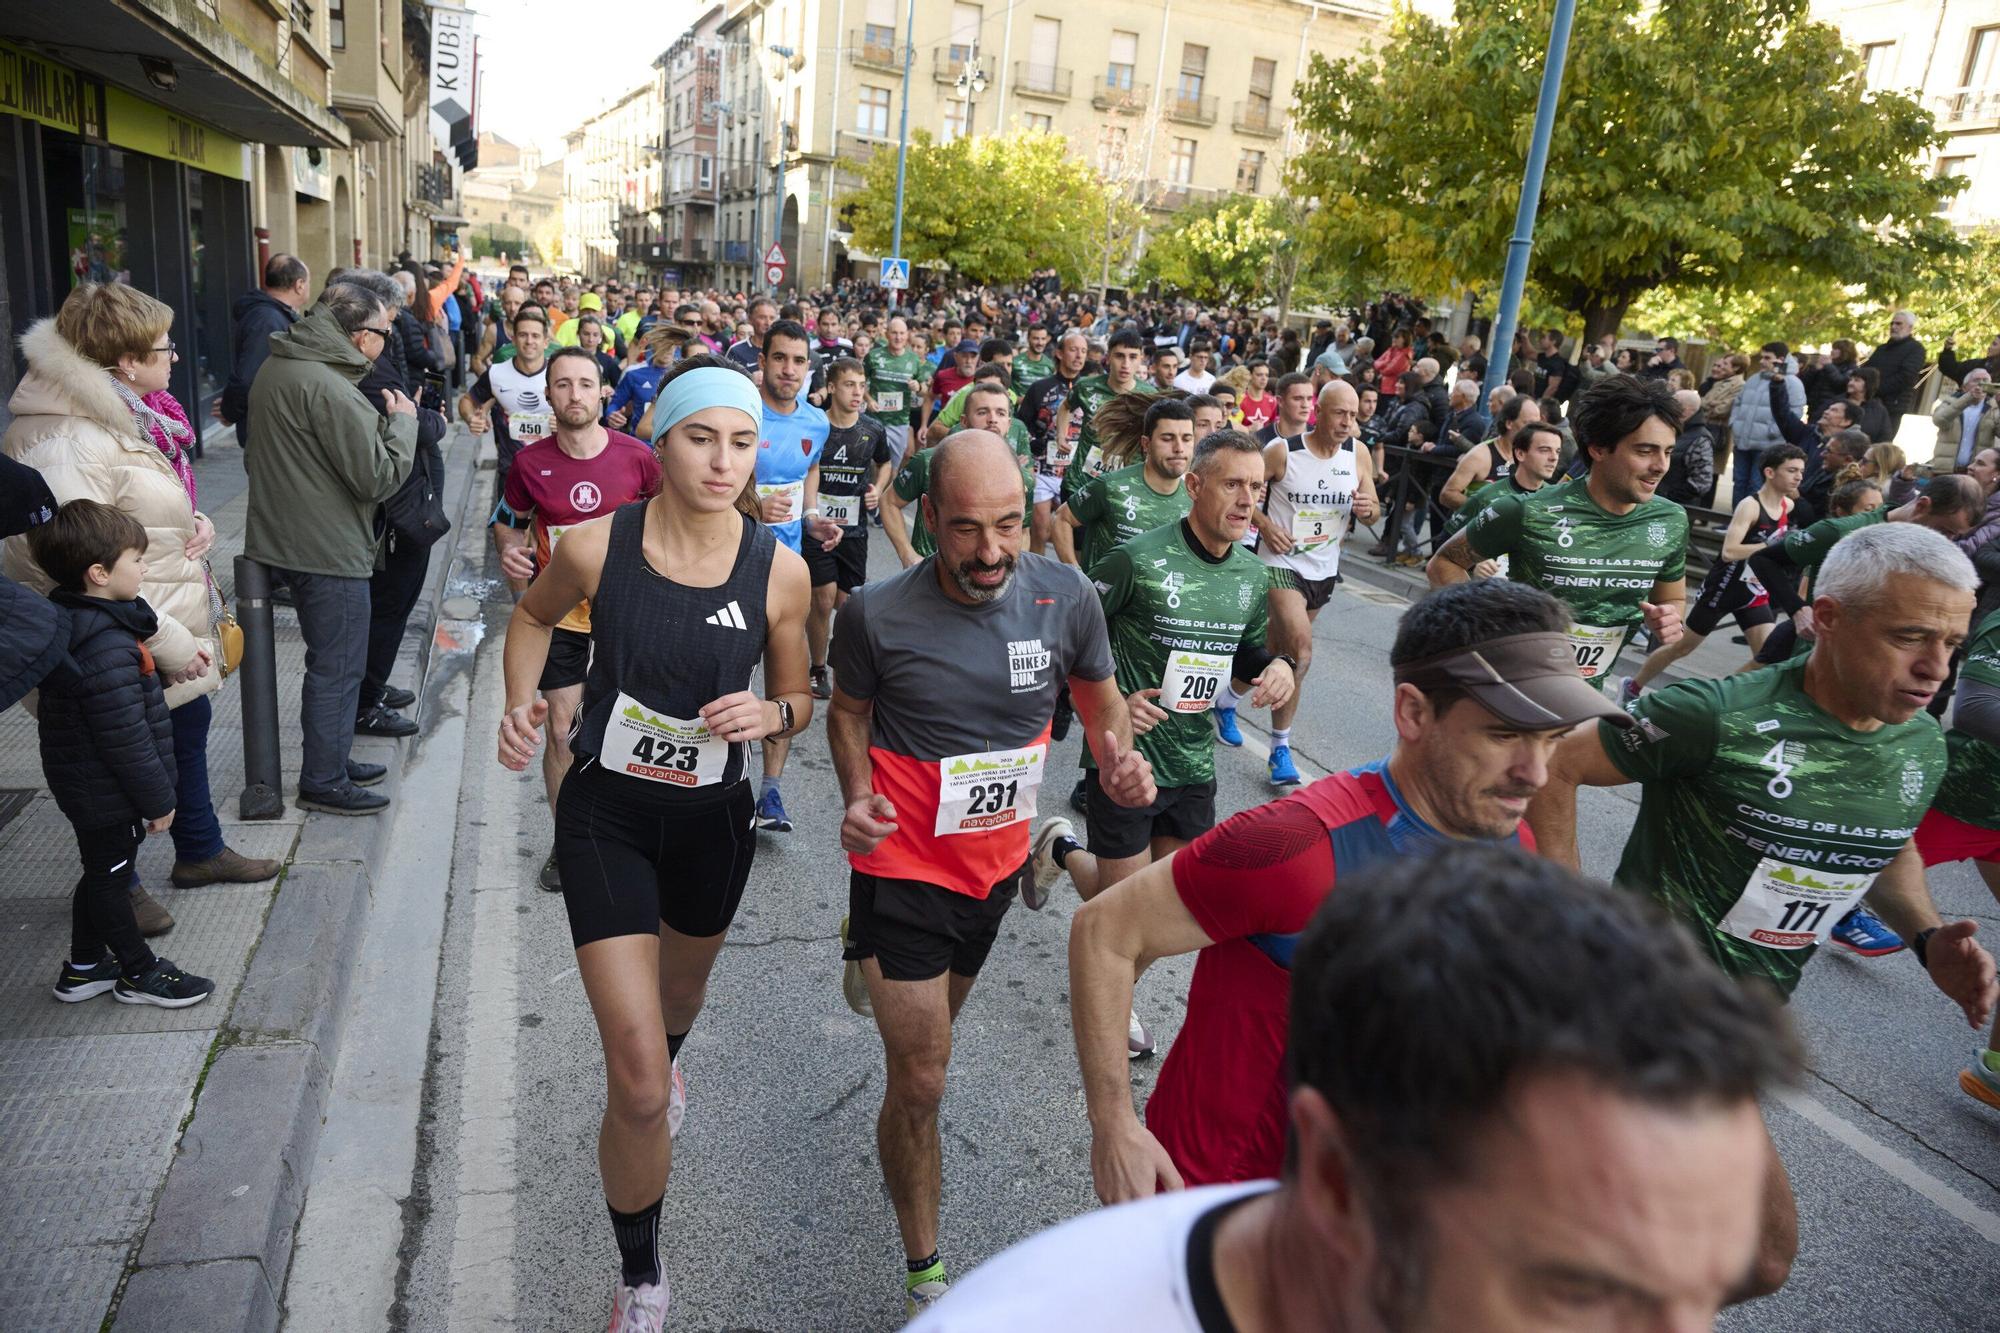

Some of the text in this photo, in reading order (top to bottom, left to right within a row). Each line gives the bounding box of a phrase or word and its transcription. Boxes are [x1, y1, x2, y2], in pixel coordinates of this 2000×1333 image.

[436, 13, 460, 90] KUBE
[22, 55, 78, 128] MILAR
[180, 120, 205, 164] MILAR
[519, 424, 542, 434] 450
[834, 444, 848, 464] 4
[824, 472, 858, 484] TAFALLA
[826, 506, 847, 518] 210
[1314, 522, 1322, 536] 3
[1544, 554, 1586, 565] CROSS
[1542, 573, 1600, 587] PEÑEN
[1154, 614, 1192, 626] CROSS
[1207, 622, 1226, 630] LAS
[1150, 632, 1239, 652] PEÑEN KROS
[1012, 655, 1047, 671] BIKE &
[1011, 671, 1038, 687] RUN.
[1180, 676, 1218, 700] 209
[632, 735, 699, 772] 423
[629, 764, 695, 784] navarban
[967, 780, 1018, 815] 231
[963, 811, 1014, 828] navarban
[1737, 804, 1810, 829] CROSS
[1812, 822, 1838, 833] DE
[1840, 825, 1878, 838] LAS
[1725, 826, 1823, 862] PEÑEN
[1777, 900, 1831, 931] 171
